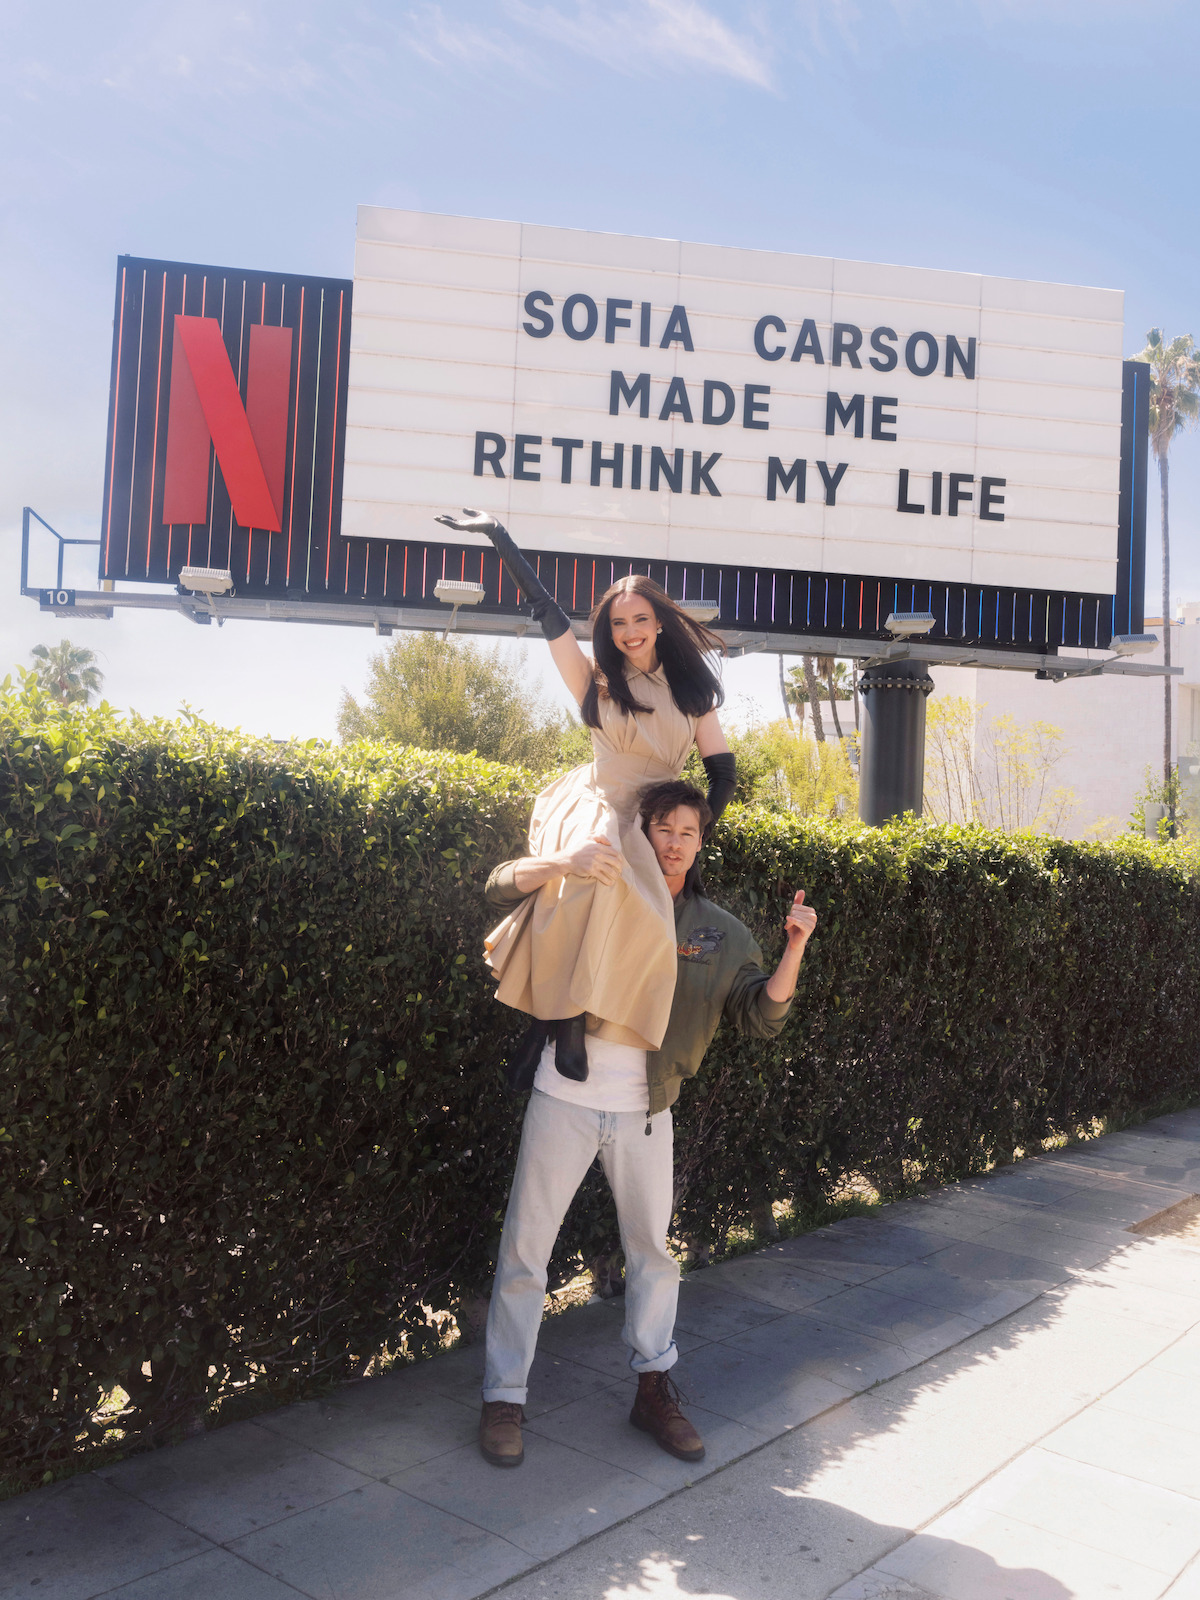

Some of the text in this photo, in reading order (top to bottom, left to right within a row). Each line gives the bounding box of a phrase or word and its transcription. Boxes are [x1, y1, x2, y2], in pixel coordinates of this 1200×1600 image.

[522, 290, 977, 380] SOFIA CARSON
[161, 314, 294, 533] N
[609, 370, 898, 442] MADE ME
[473, 431, 1007, 522] RETHINK MY LIFE
[46, 590, 69, 605] 10
